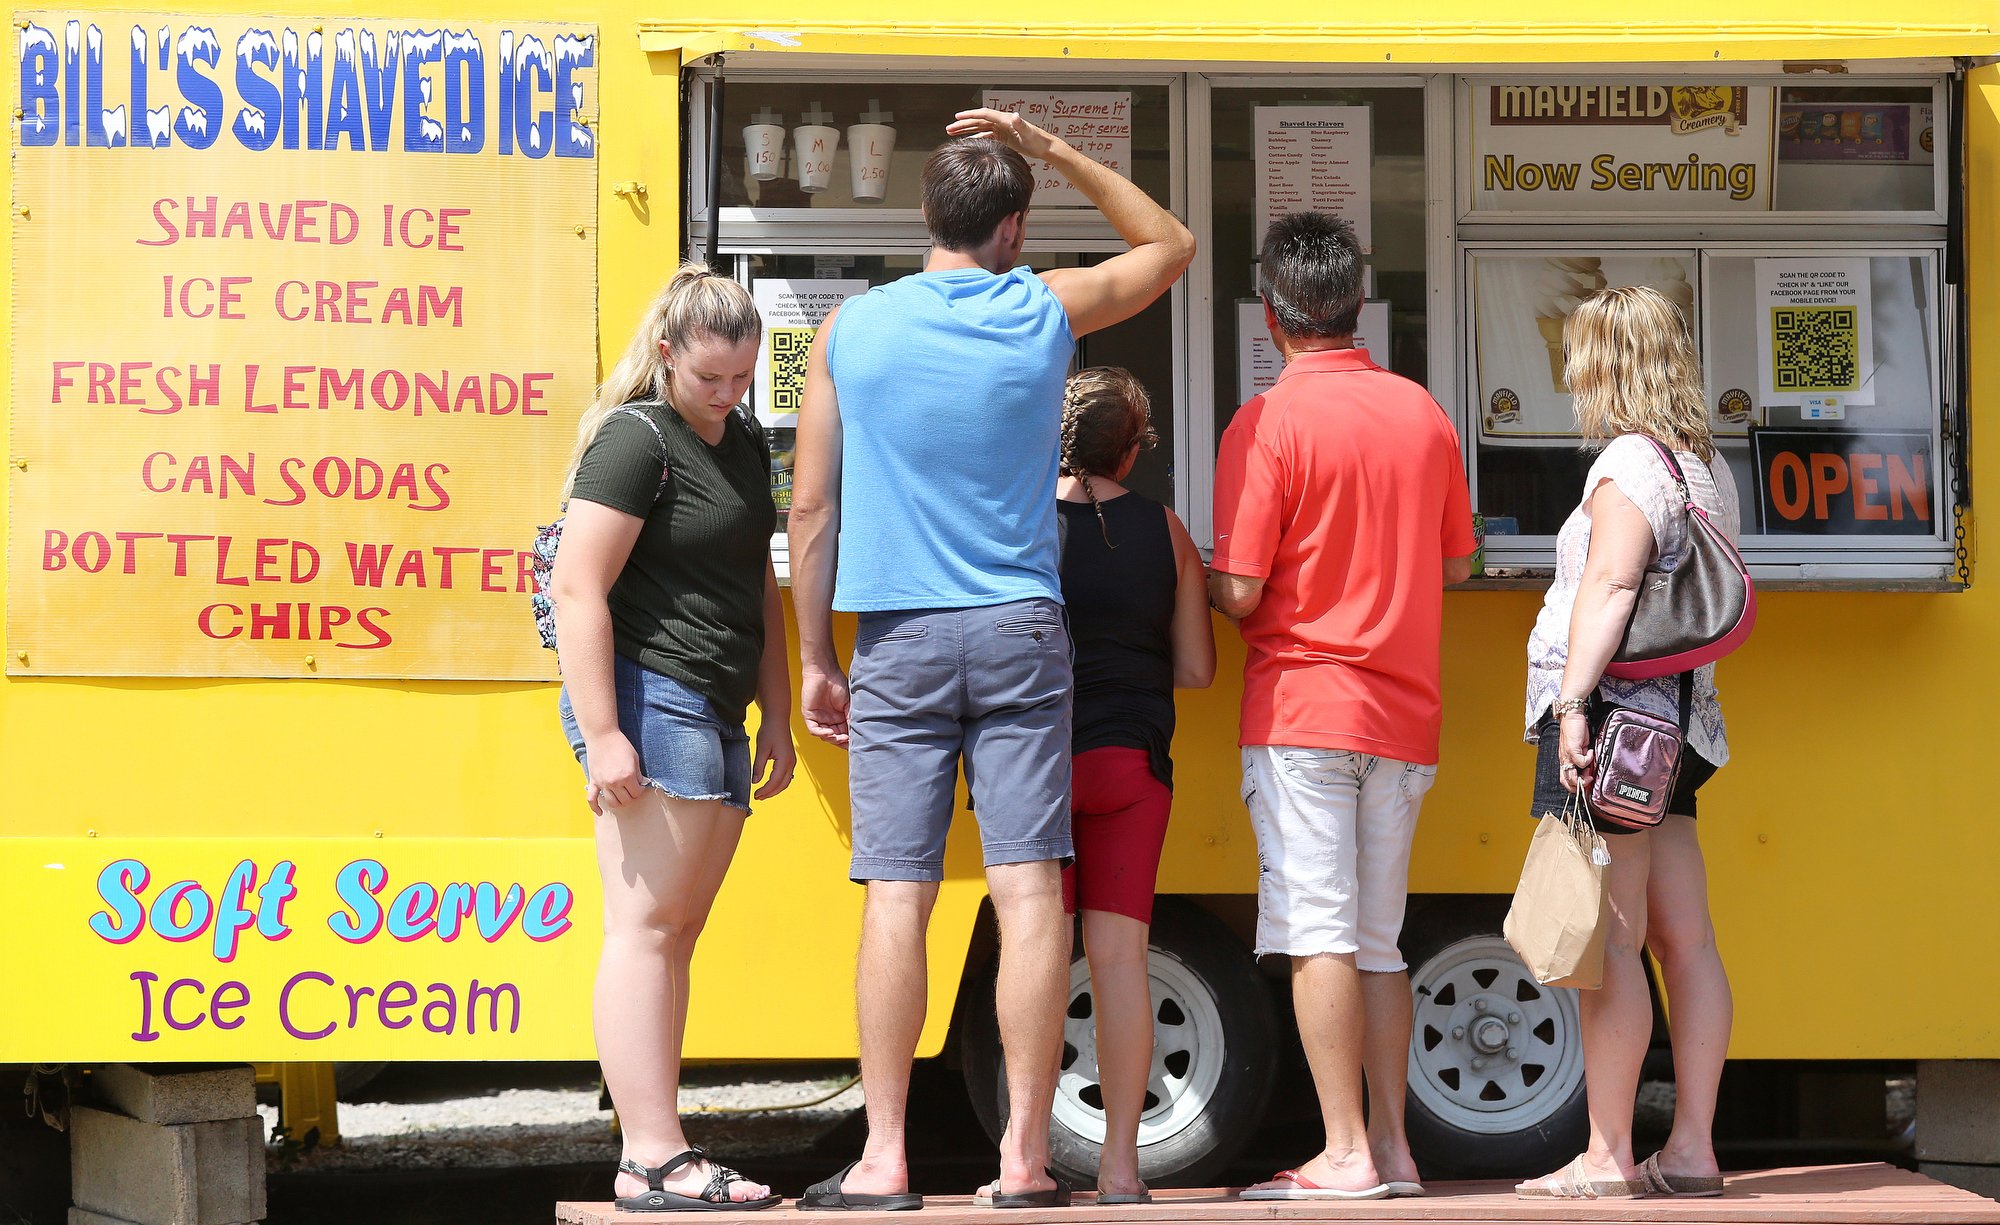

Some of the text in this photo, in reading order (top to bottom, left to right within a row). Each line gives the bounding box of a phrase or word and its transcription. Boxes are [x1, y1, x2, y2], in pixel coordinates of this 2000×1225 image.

[19, 20, 596, 159] BILL'S SHAVED ICE
[1500, 86, 1668, 118] MAYFIELD
[987, 99, 1025, 113] Just
[1029, 103, 1049, 121] say
[1680, 113, 1727, 132] Creamery
[762, 133, 770, 146] S
[1035, 122, 1129, 135] illa soft serve
[812, 139, 824, 152] M
[871, 141, 882, 156] L
[1069, 141, 1112, 152] nd top
[805, 161, 830, 174] 2.00
[861, 167, 885, 180] 2.50
[1484, 153, 1756, 200] Now Serving
[136, 196, 471, 251] SHAVED ICE
[163, 275, 464, 327] ICE CREAM
[51, 362, 554, 416] FRESH LEMONADE
[1492, 390, 1518, 406] MAYFIELD
[1721, 390, 1750, 406] MAYFIELD
[142, 452, 451, 511] CAN SODAS
[1769, 451, 1930, 521] OPEN
[42, 529, 540, 593] BOTTLED WATER
[198, 602, 392, 648] CHIPS
[1619, 784, 1650, 802] PINK
[88, 858, 573, 962] Soft Serve
[130, 971, 520, 1041] Ice Cream
